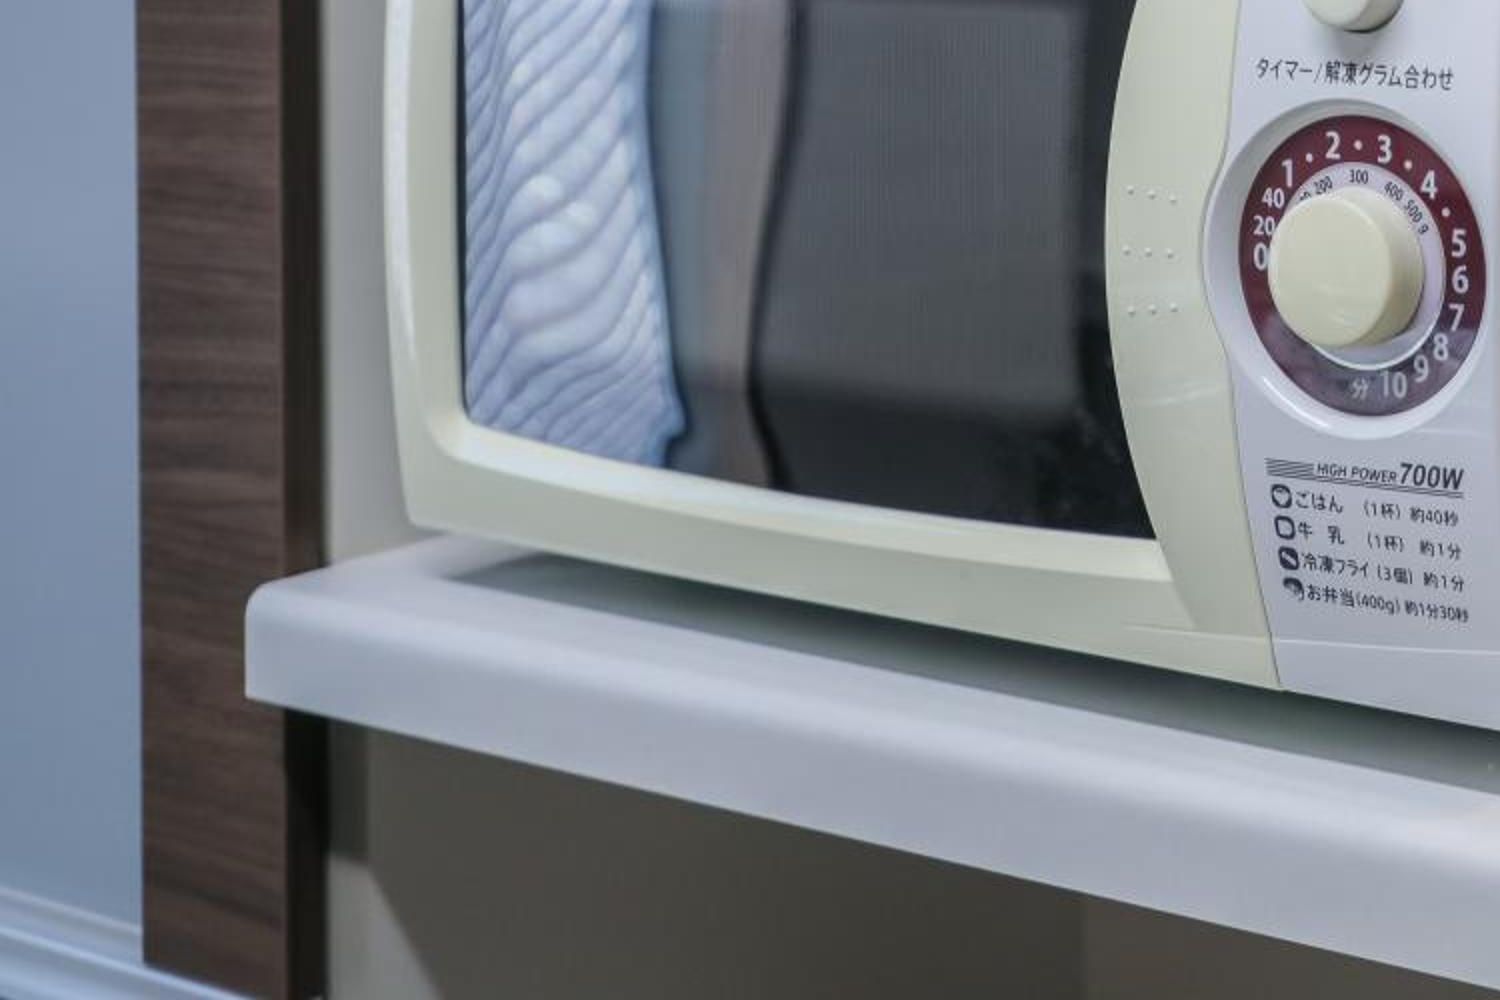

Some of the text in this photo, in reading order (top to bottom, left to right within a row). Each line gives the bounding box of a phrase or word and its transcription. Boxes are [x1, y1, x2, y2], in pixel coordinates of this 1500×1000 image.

[1256, 58, 1454, 90] タイマー/解凍グラム合わせ
[1325, 131, 1341, 159] 2
[1377, 134, 1392, 163] 3
[1282, 159, 1293, 187] 1
[1349, 169, 1368, 184] 300
[1420, 170, 1437, 199] 4
[1262, 188, 1285, 208] 40
[1383, 181, 1404, 202] 400
[1403, 200, 1423, 224] 500
[1253, 216, 1275, 236] 20
[1451, 229, 1466, 256] 5
[1254, 243, 1268, 270] 0
[1452, 266, 1468, 293] 6
[1449, 304, 1464, 332] 7
[1433, 334, 1448, 361] 8
[1414, 355, 1429, 382] 9
[1353, 378, 1368, 398] 分
[1381, 371, 1407, 398] 10
[1317, 462, 1465, 490] HIGH POWER 700W
[1296, 490, 1344, 514] ごはん
[1410, 506, 1459, 526] 約40秒
[1420, 540, 1461, 561] 約1分
[1302, 552, 1370, 578] 冷凍フライ
[1423, 571, 1465, 592] 約1分
[1404, 601, 1468, 623] 約1分30秒
